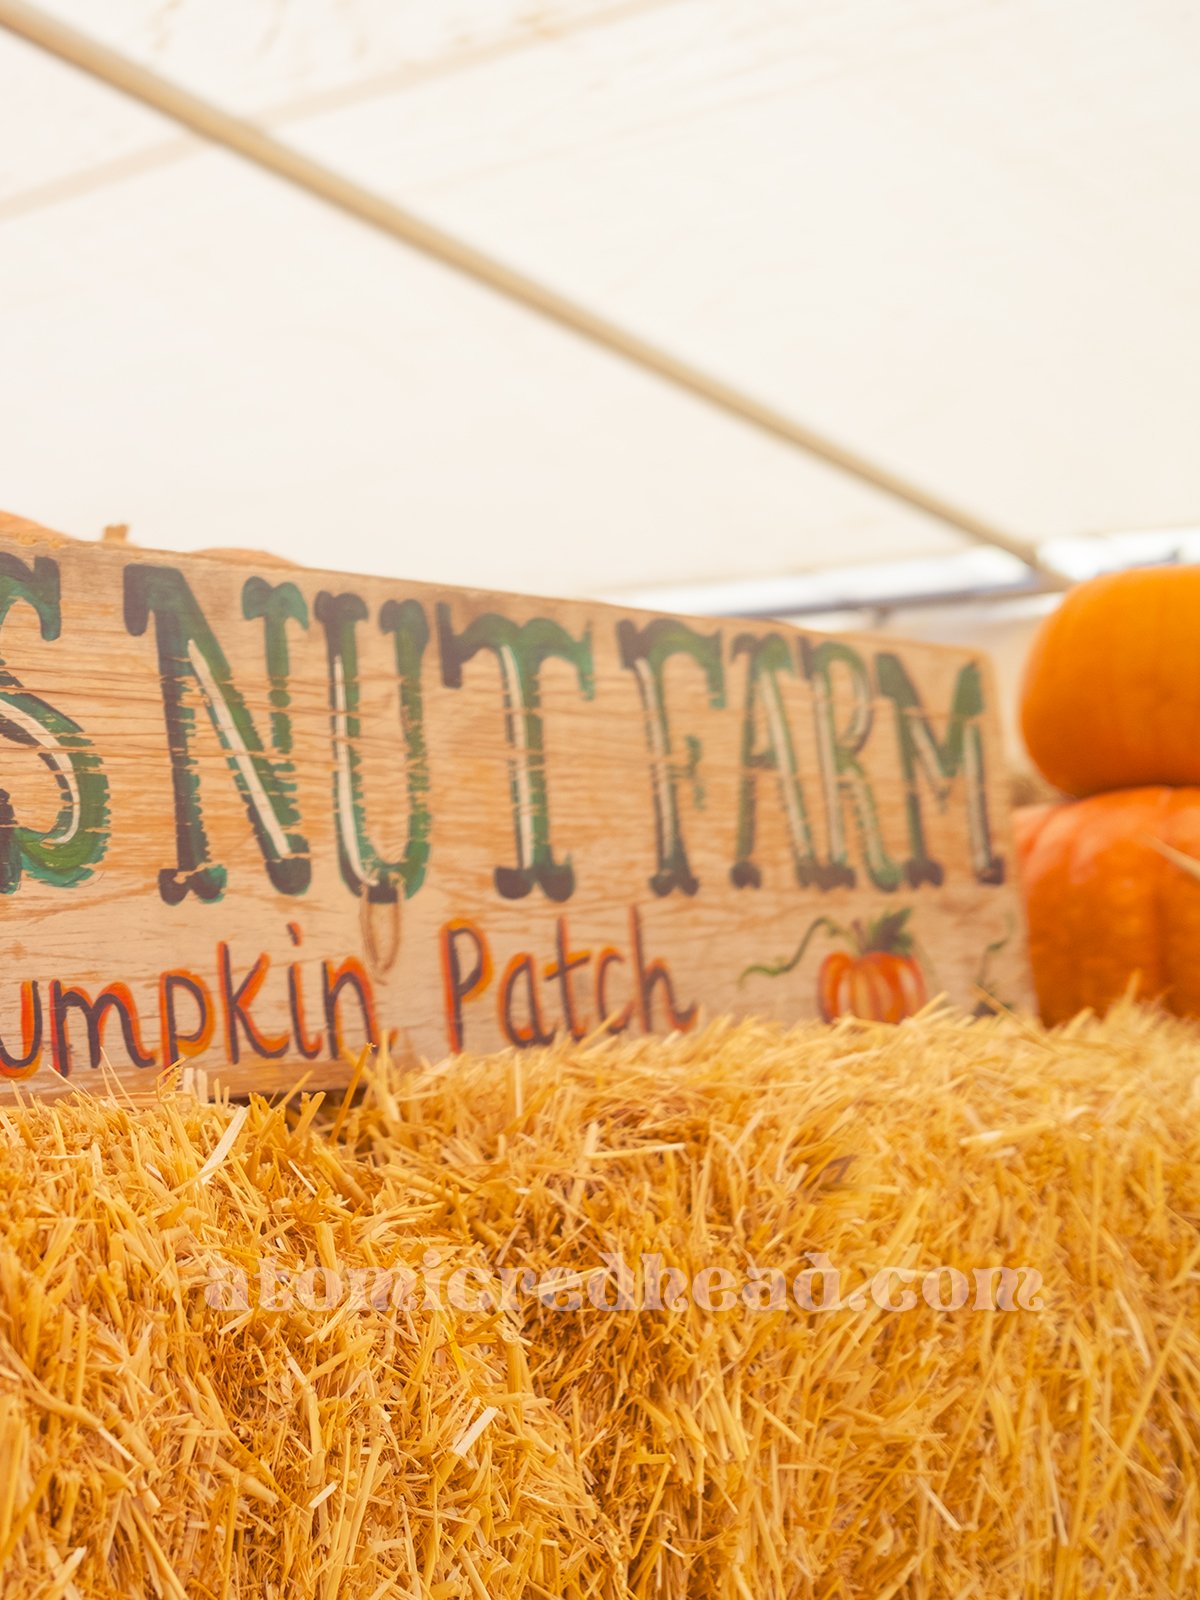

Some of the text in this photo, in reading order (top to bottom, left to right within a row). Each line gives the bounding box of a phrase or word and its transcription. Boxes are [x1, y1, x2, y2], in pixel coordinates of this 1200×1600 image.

[123, 563, 594, 905] NUT
[616, 618, 1006, 897] FARM
[439, 905, 698, 1054] Patch
